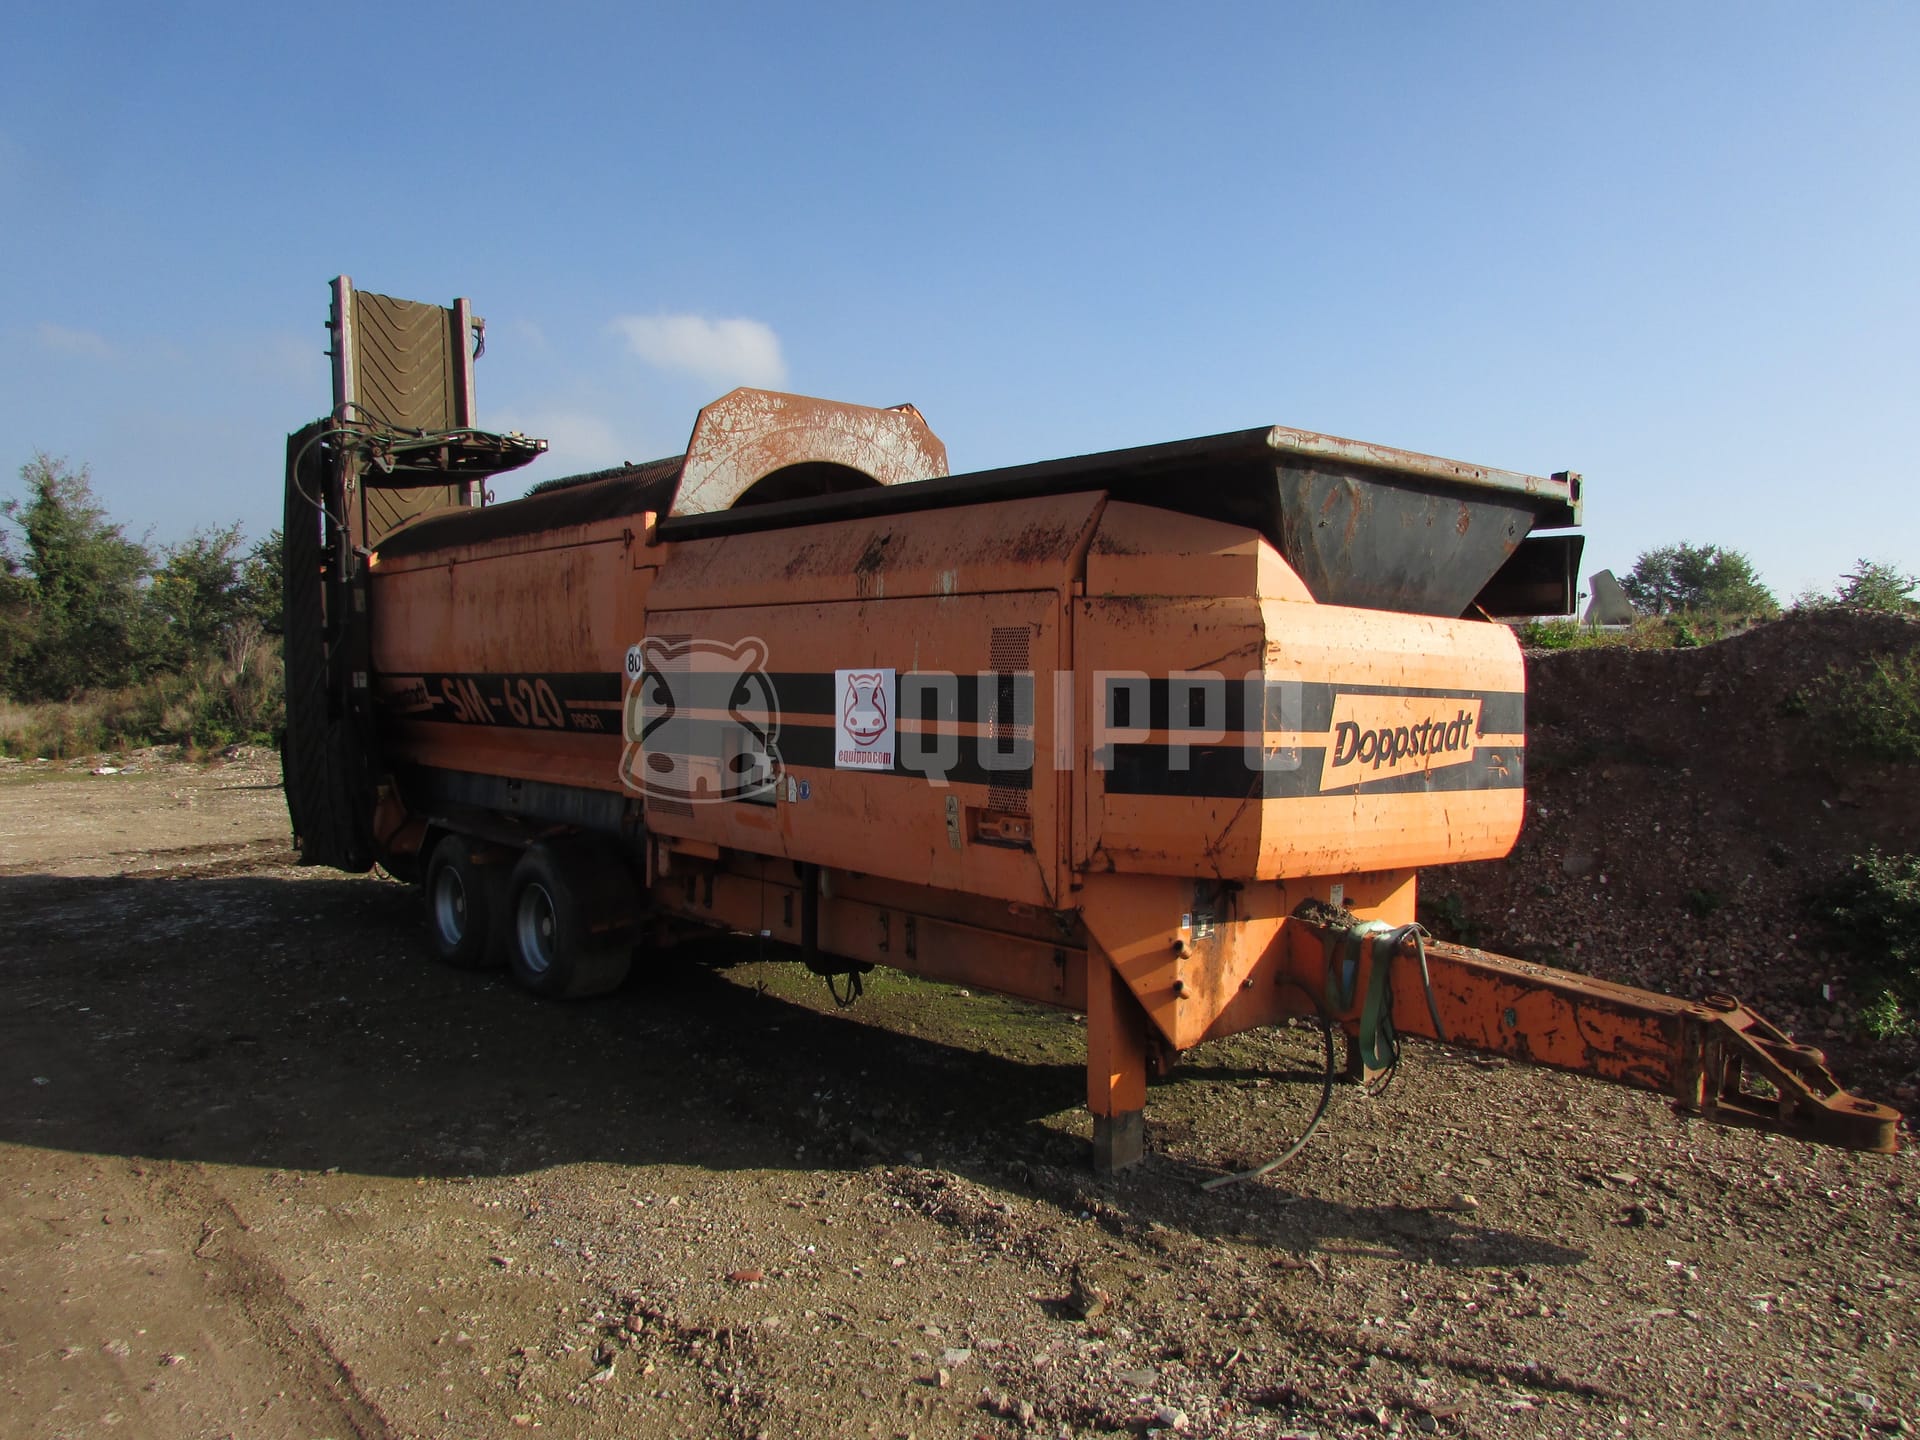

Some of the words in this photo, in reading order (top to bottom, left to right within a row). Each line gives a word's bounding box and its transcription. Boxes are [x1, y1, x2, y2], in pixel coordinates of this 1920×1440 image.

[628, 653, 641, 673] 80
[441, 677, 565, 728] SM-620
[838, 748, 892, 766] equippo.com
[1331, 709, 1474, 770] Doppstadt
